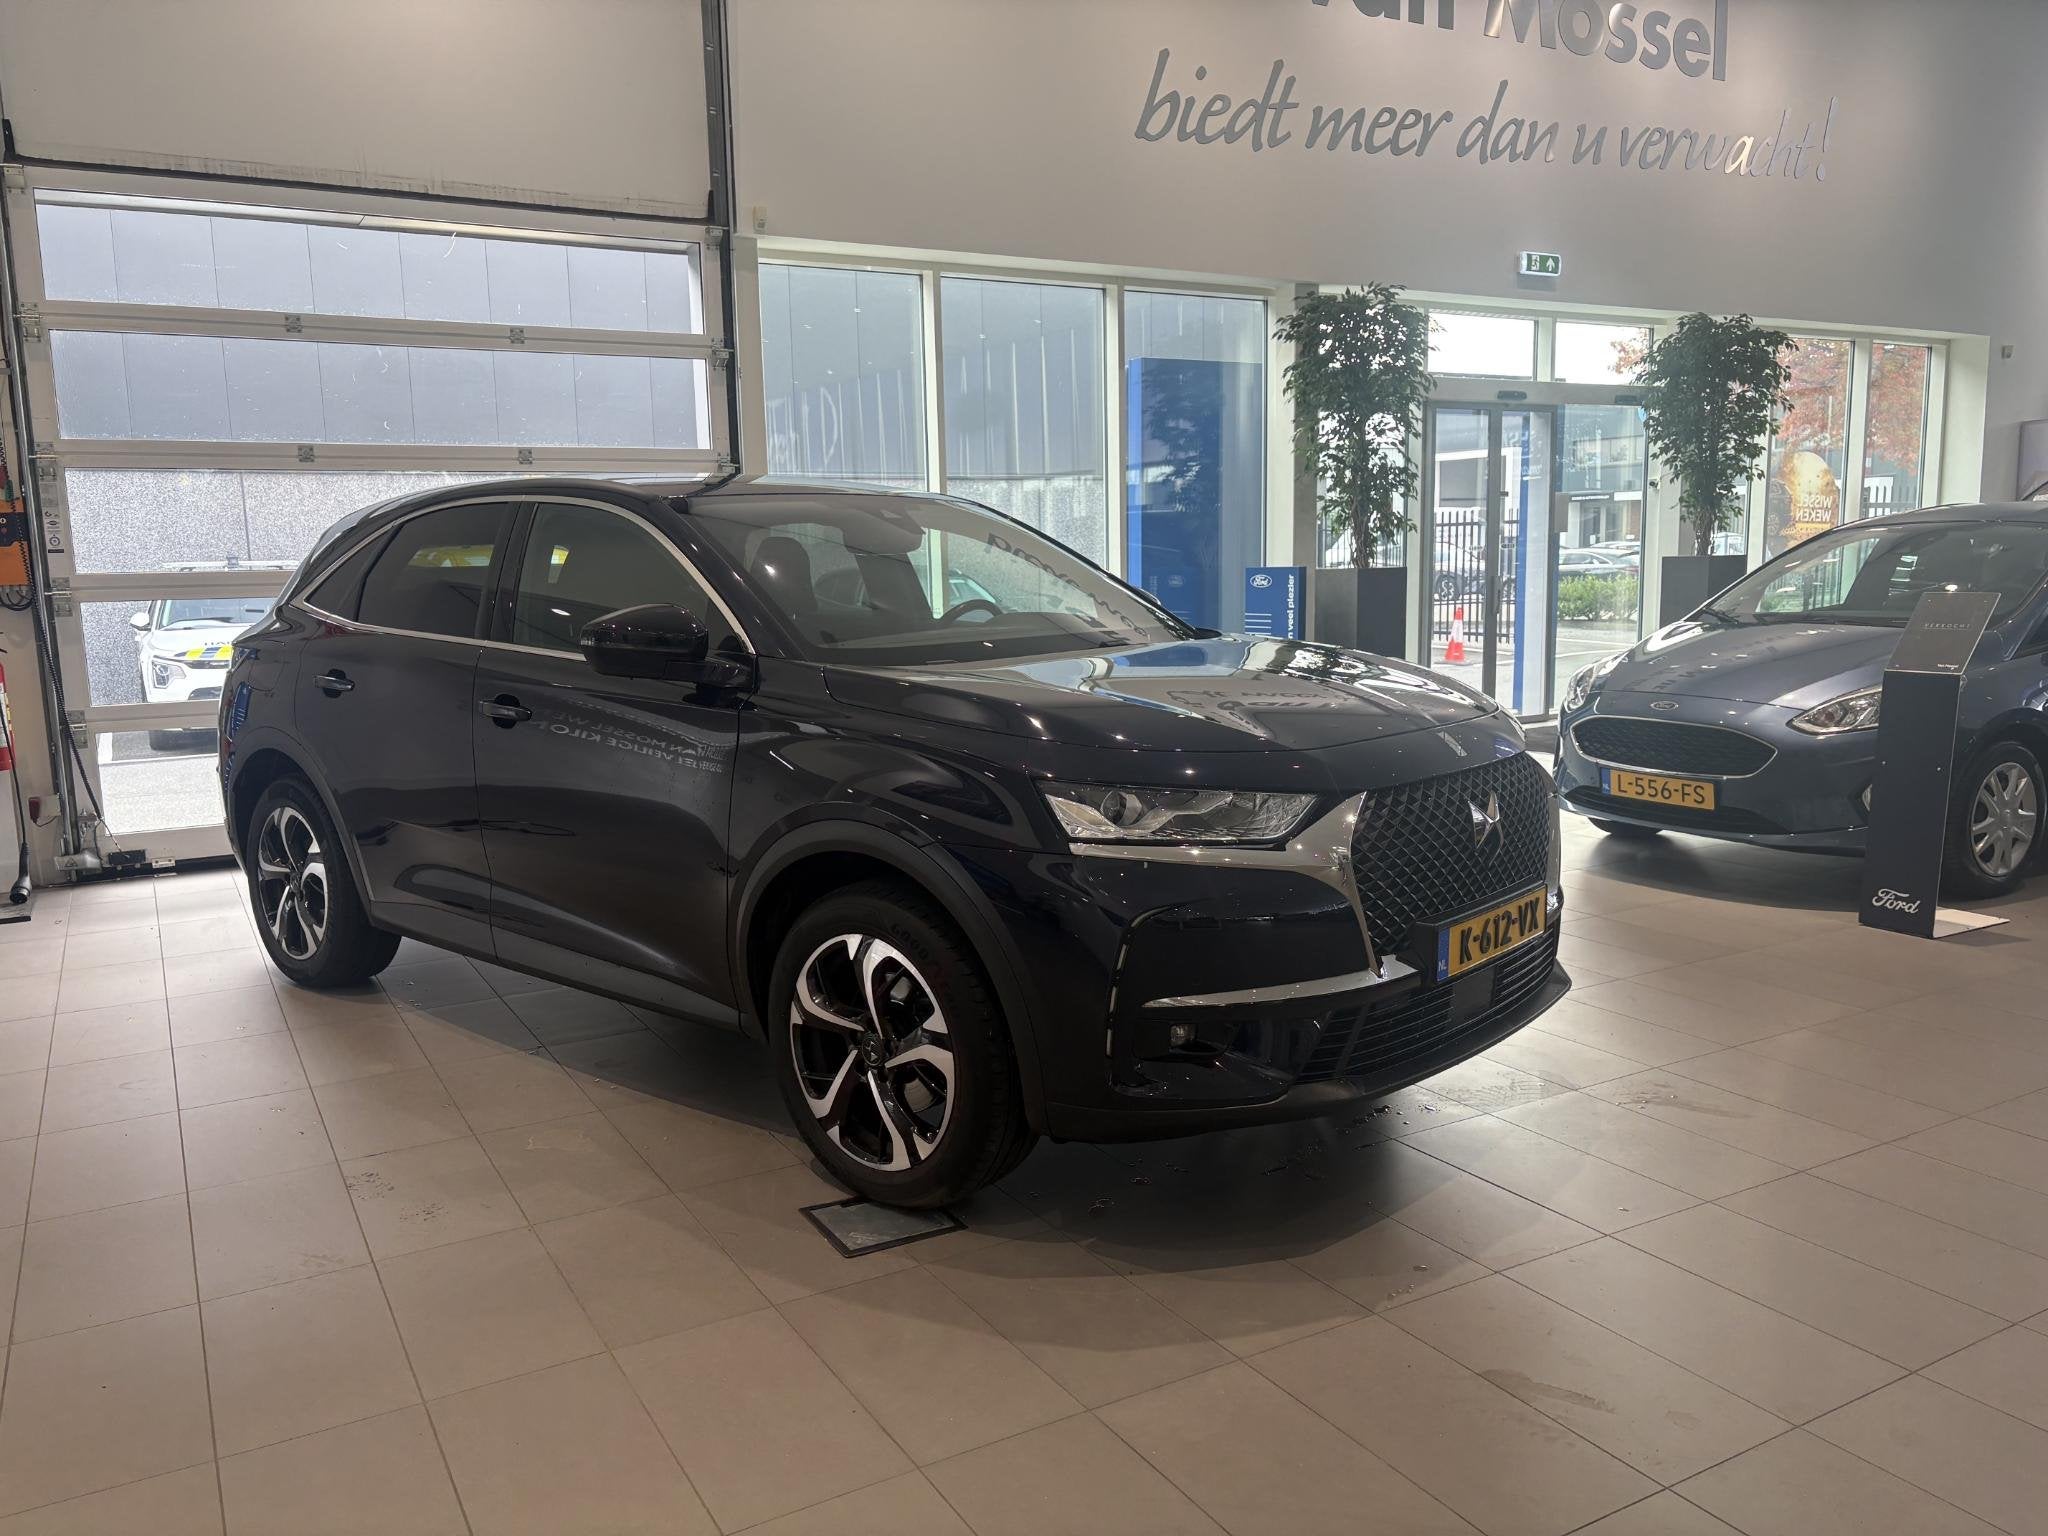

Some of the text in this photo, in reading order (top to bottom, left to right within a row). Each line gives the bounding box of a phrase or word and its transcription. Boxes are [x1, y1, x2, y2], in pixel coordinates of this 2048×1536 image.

[1134, 47, 1839, 182] biedt meer dan u verwacht!
[1617, 774, 1705, 804] L-556-FS
[1872, 888, 1921, 914] Ford
[1459, 897, 1540, 965] K-612-VX
